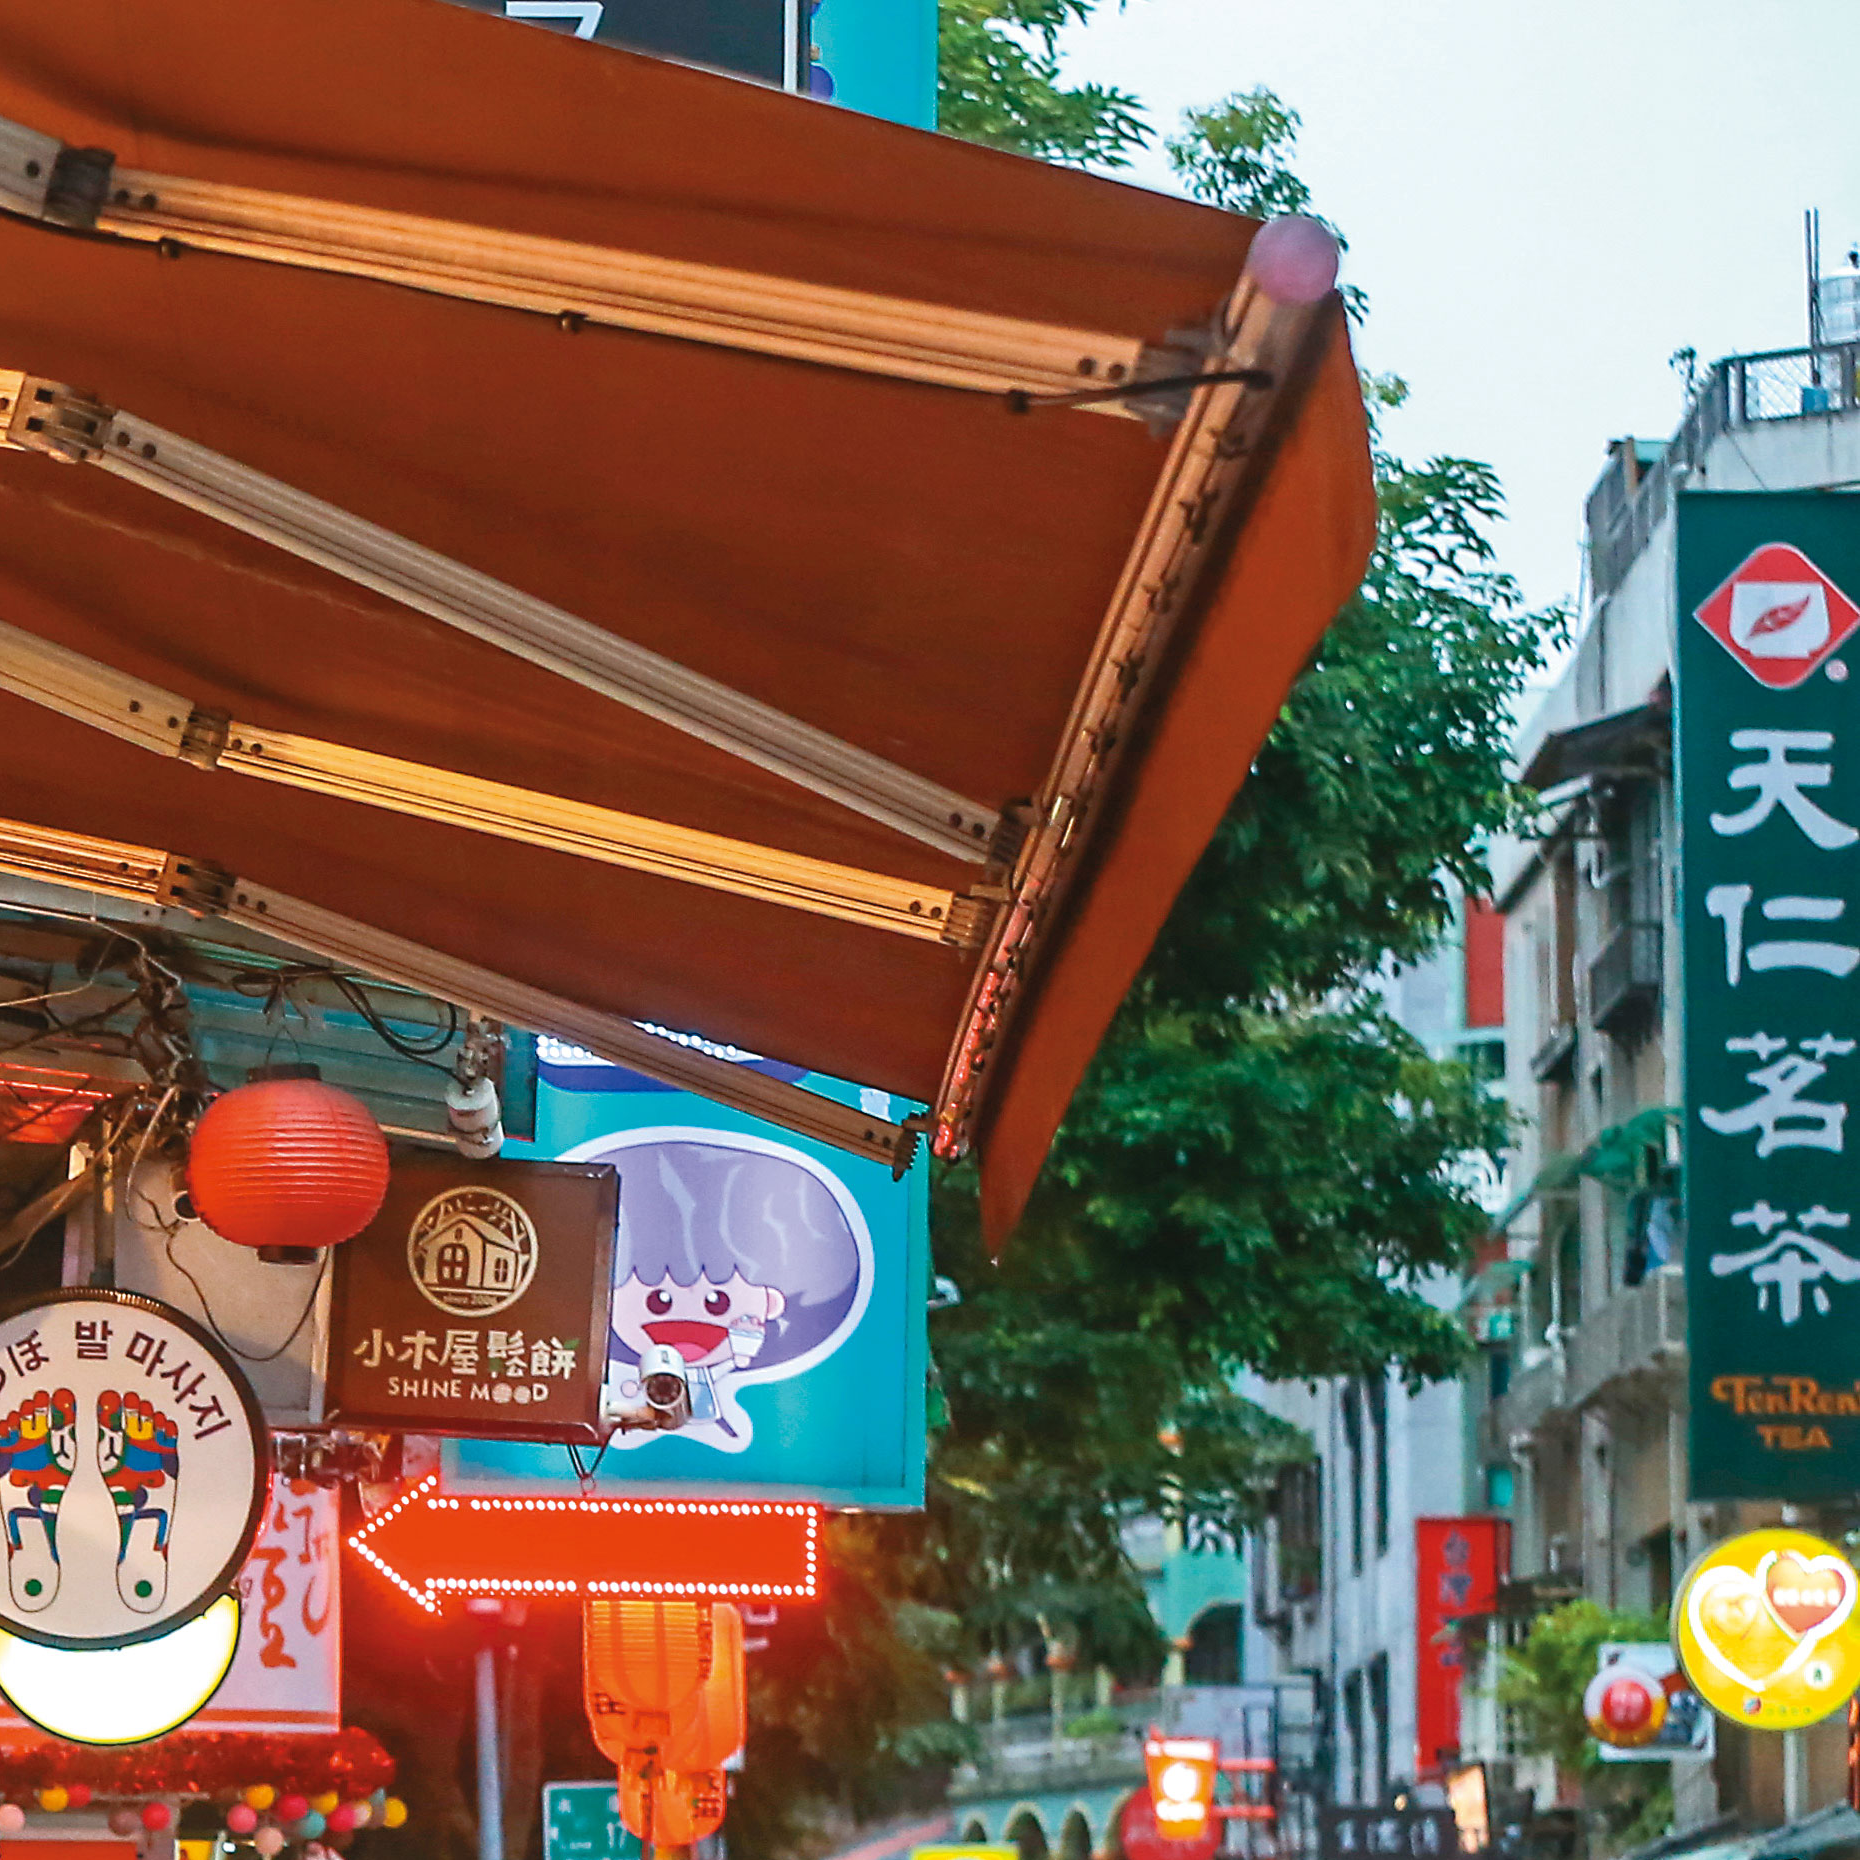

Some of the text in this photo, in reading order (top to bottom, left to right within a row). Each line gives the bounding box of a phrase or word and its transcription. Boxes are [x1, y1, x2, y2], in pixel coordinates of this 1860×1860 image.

[1699, 729, 1860, 1327] 天仁茗茶
[74, 1320, 232, 1440] 발 마사지
[353, 1328, 580, 1380] 小木屋鬆餅
[388, 1376, 549, 1405] SHINE MOOD
[1756, 1424, 1831, 1449] TEA
